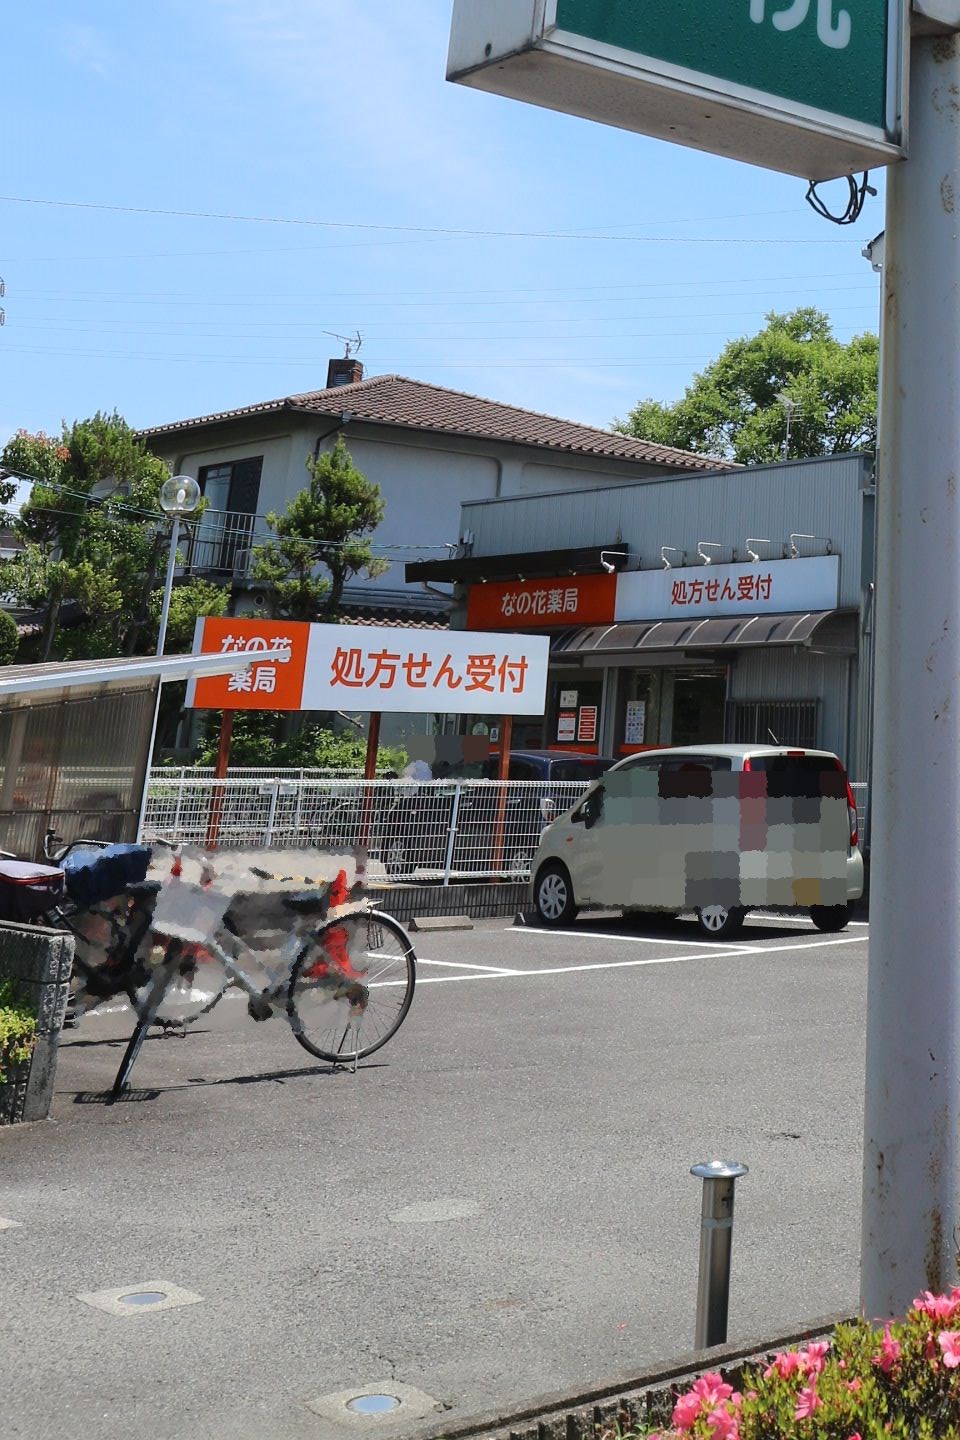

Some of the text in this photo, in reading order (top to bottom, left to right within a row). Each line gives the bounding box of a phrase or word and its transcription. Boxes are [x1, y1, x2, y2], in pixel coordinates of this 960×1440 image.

[501, 587, 578, 616] なの花薬局
[671, 574, 773, 606] 処方せん受付
[227, 667, 276, 694] 薬局
[330, 646, 529, 694] 処方せん受付
